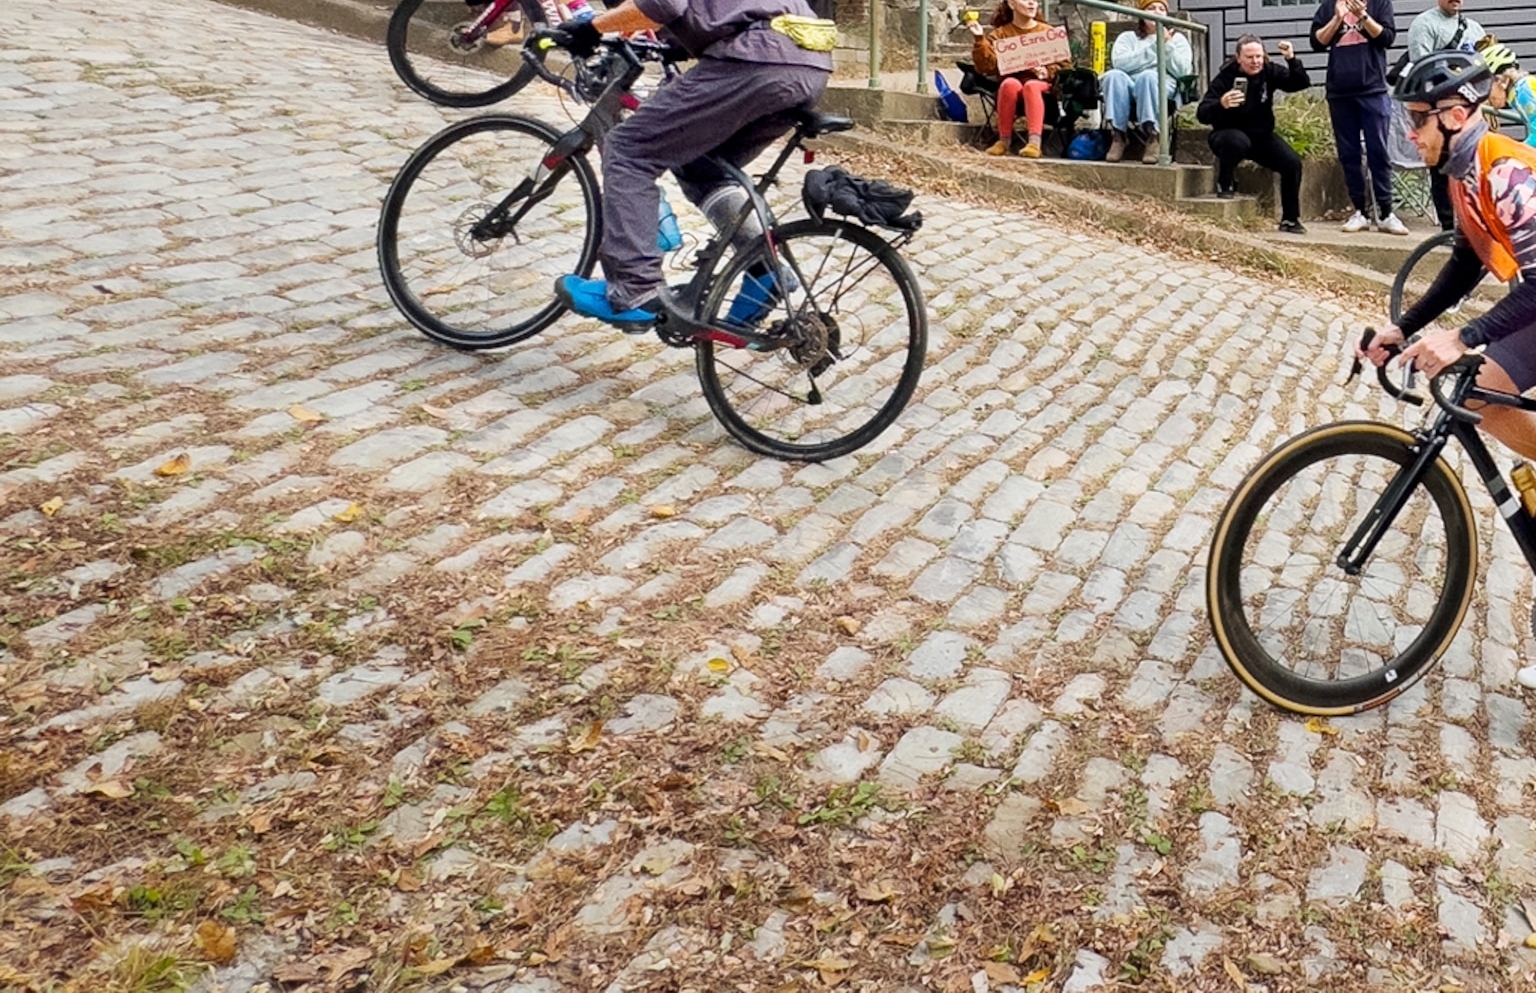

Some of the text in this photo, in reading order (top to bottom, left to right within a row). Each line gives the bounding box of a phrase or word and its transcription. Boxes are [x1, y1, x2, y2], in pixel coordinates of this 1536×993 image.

[996, 28, 1067, 53] Go Ezra Go
